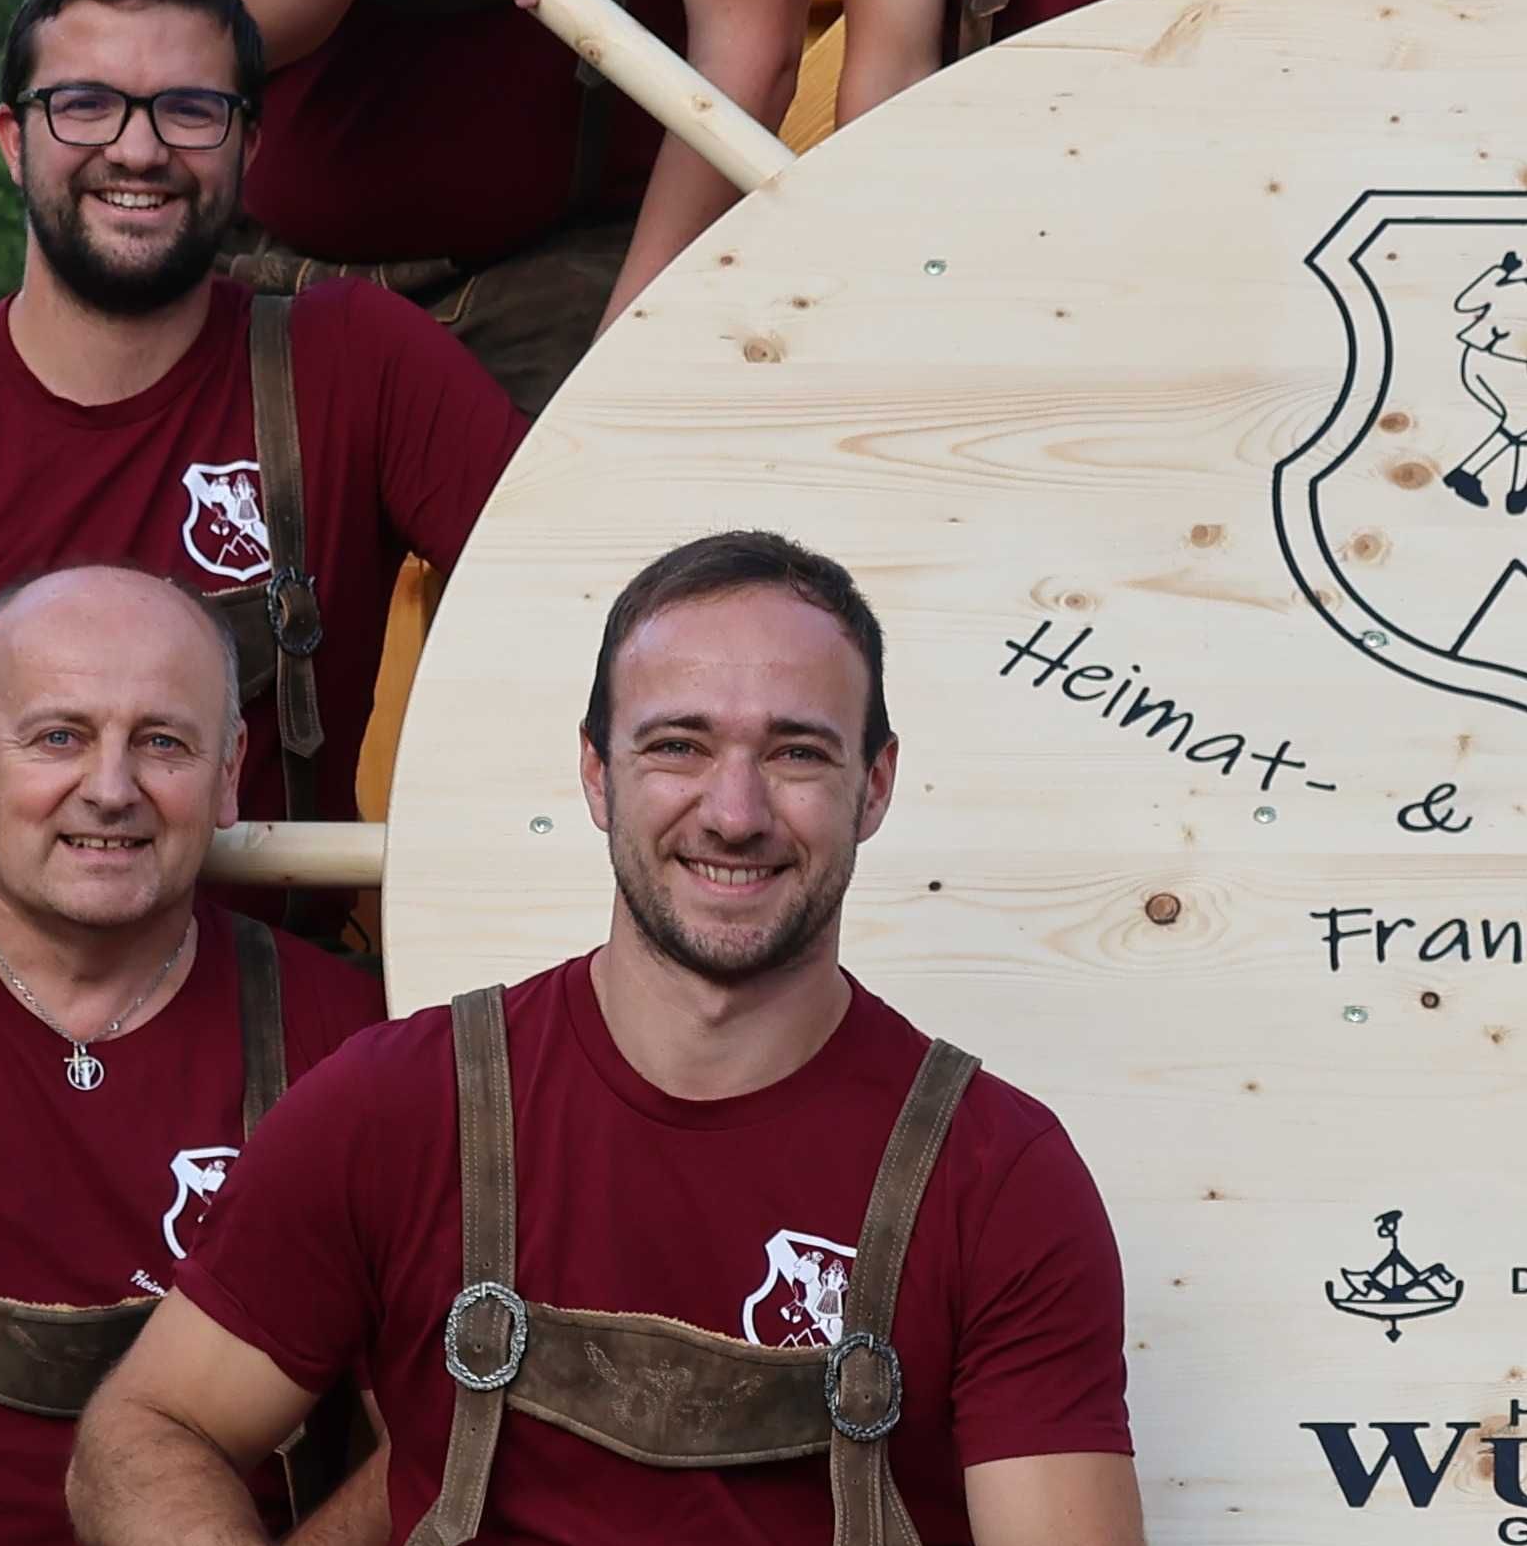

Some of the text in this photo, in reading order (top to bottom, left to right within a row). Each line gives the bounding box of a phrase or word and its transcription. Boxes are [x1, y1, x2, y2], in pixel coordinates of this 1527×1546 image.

[999, 617, 1339, 793] Heimat-
[1397, 783, 1473, 834] &
[130, 1269, 168, 1297] Heim
